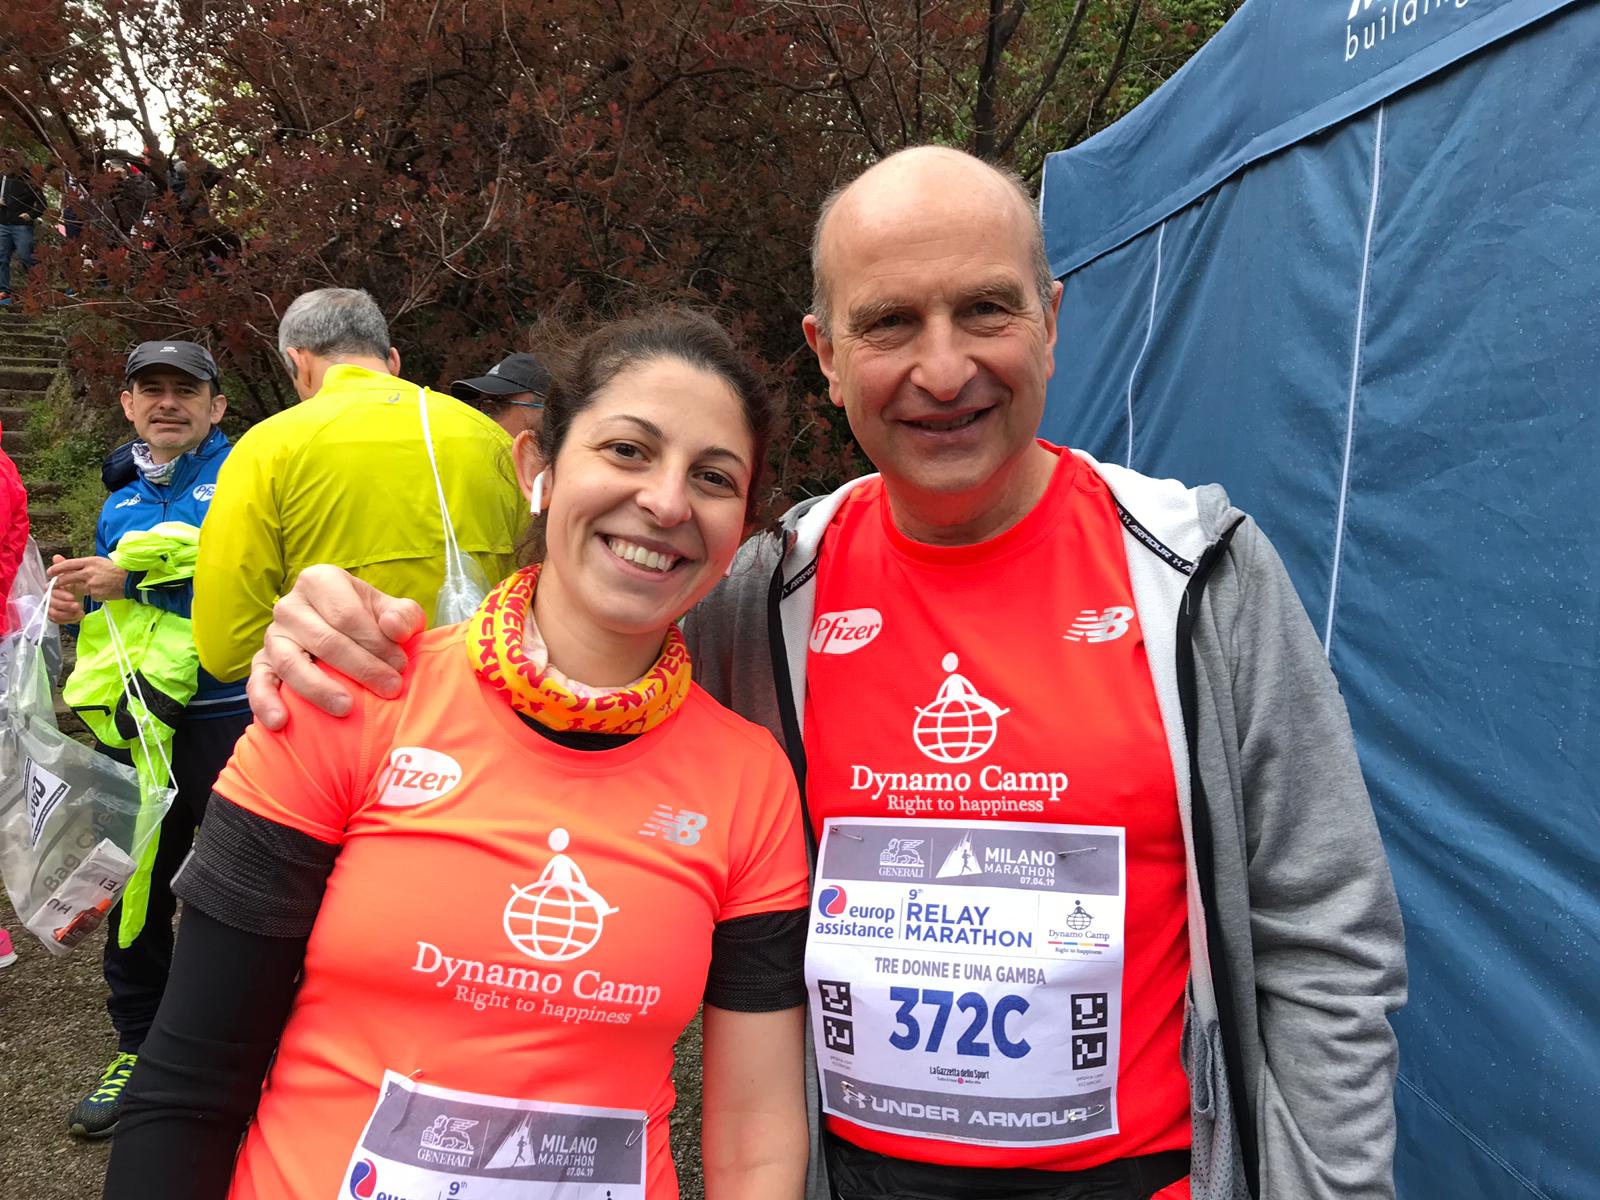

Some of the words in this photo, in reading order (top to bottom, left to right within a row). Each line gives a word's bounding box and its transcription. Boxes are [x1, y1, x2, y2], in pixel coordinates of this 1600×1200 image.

[1129, 524, 1172, 559] ARMOUR
[814, 616, 880, 653] Pfizer
[378, 753, 457, 802] fizer
[850, 764, 971, 800] Dynamo
[979, 765, 1069, 801] Camp
[887, 794, 932, 815] Right
[937, 797, 955, 811] to
[959, 796, 1044, 816] happiness
[985, 847, 1056, 866] MILANO
[43, 854, 81, 893] Bag
[879, 866, 924, 878] GENERALI
[984, 863, 1055, 878] MARATHON
[1019, 876, 1055, 887] 07.04.19
[849, 904, 895, 923] europ
[906, 902, 990, 926] RELAY
[815, 920, 894, 939] assistance
[905, 924, 1033, 948] MARATHON
[1048, 929, 1083, 940] Dynamo
[1085, 931, 1110, 942] Camp
[411, 941, 562, 994] Dynamo
[572, 969, 661, 1016] Camp
[874, 957, 899, 974] TRE
[902, 960, 949, 978] DONNE
[952, 963, 960, 979] E
[963, 964, 992, 982] UNA
[996, 966, 1047, 985] GAMBA
[454, 984, 510, 1011] Right
[515, 995, 536, 1013] to
[540, 1000, 632, 1025] happiness
[888, 985, 1032, 1060] 372C
[872, 1098, 960, 1123] UNDER
[967, 1107, 1088, 1128] ARMOUR
[541, 1134, 598, 1154] MILANO
[417, 1148, 472, 1168] GENERALI
[538, 1153, 595, 1167] MARATHON
[566, 1167, 594, 1177] 07.04.19
